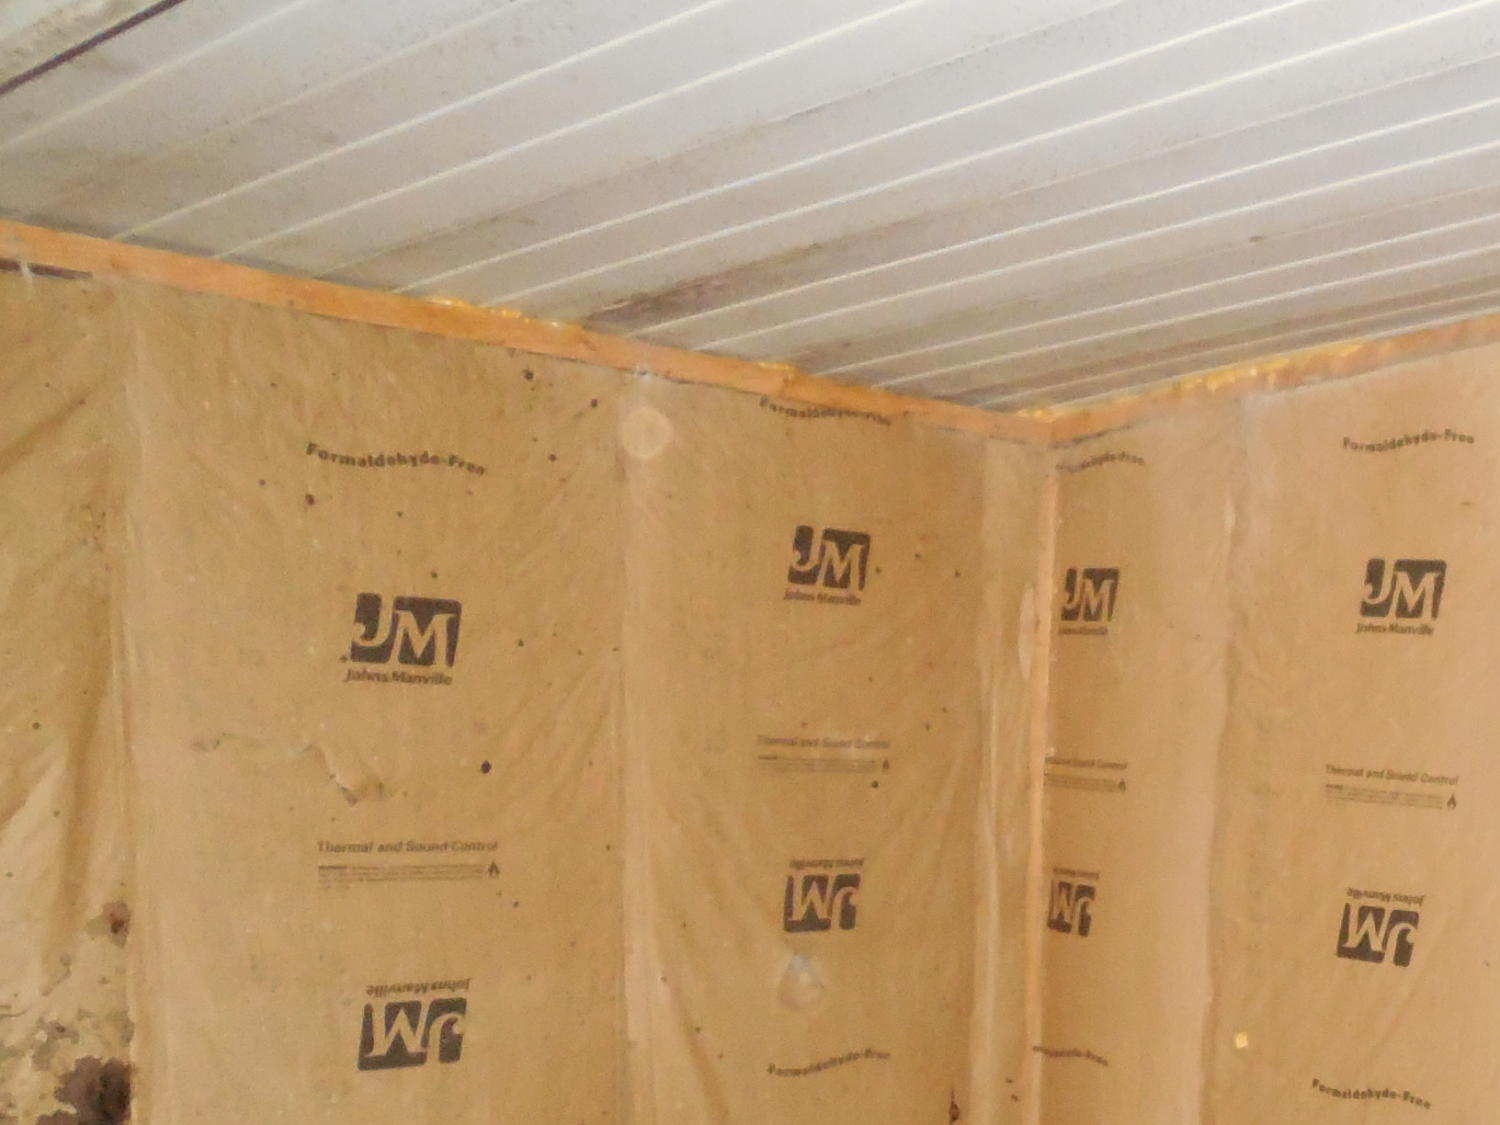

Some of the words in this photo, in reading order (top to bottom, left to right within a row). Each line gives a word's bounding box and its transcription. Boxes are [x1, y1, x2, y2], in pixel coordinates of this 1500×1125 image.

[787, 525, 871, 592] JM
[1360, 557, 1447, 621] JM
[1061, 567, 1120, 622] JM
[350, 592, 462, 669] JM
[783, 873, 861, 933] JM
[1336, 902, 1420, 968] JM
[357, 997, 467, 1071] JM
